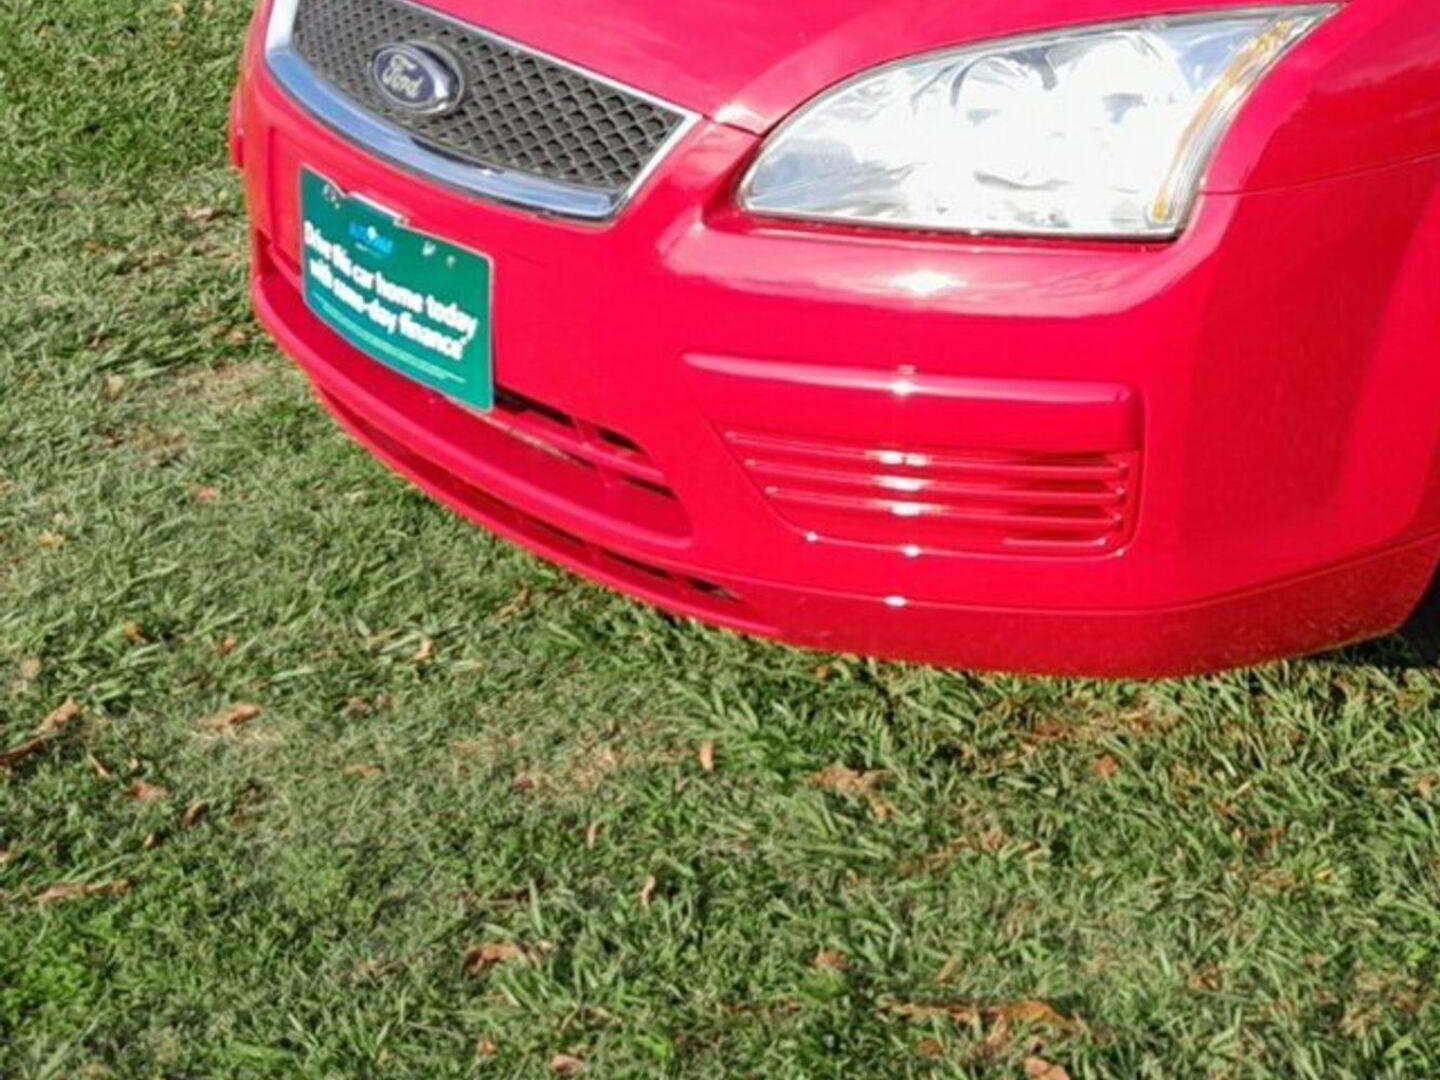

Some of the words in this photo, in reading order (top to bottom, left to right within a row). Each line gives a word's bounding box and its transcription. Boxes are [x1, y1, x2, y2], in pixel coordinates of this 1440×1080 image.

[382, 53, 424, 98] Ford
[352, 264, 375, 290] car
[375, 270, 424, 314] home
[426, 294, 479, 340] today
